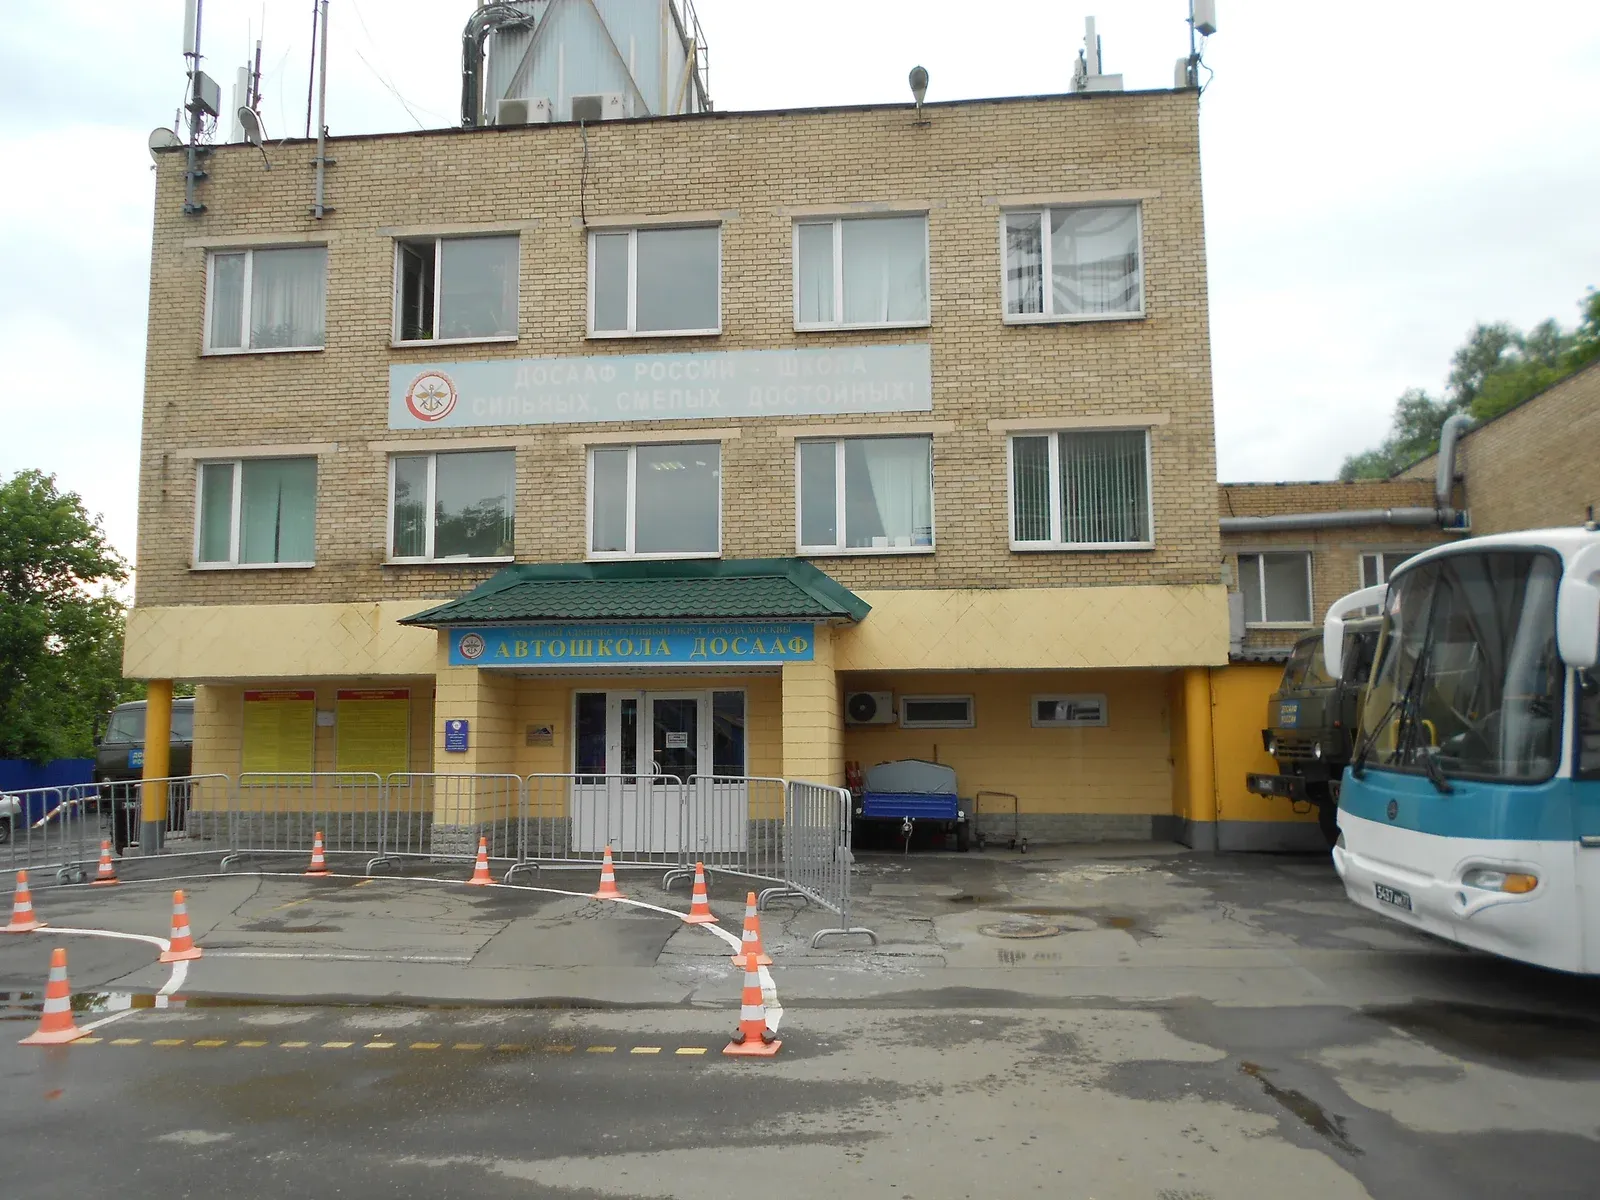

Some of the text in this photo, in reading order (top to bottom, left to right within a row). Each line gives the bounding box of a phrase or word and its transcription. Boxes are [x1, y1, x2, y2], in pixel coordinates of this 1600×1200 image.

[514, 364, 616, 390] ДОСААФ
[634, 359, 736, 383] РОССИИ
[780, 353, 867, 377] ШКОЛА
[472, 381, 915, 418] СИЛЬНЫХ, СМЕЛЫХ ДОСТОЙНЫХ!
[707, 626, 745, 636] ГОРОДА
[747, 625, 792, 635] МОСКВЫ
[495, 635, 809, 661] АВТОШКОЛА ДОСААФ
